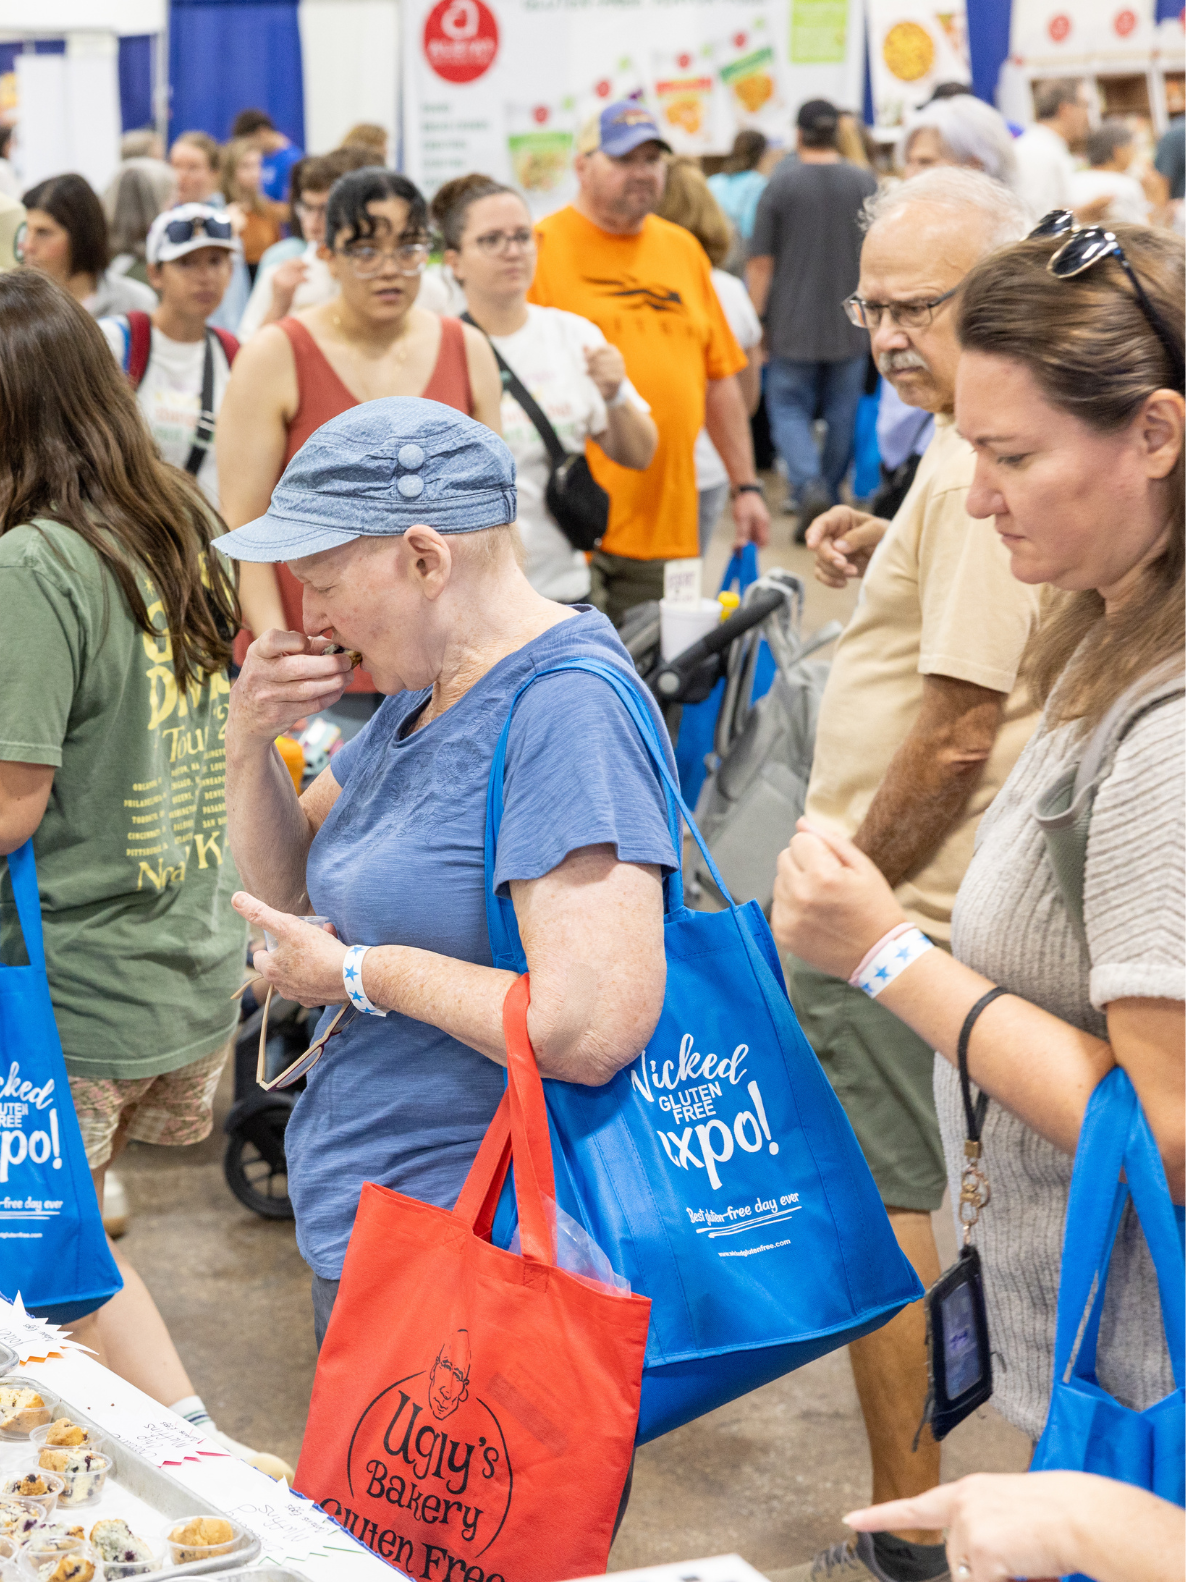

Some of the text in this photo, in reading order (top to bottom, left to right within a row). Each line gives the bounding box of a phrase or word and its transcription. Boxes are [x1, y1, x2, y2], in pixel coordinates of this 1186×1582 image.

[658, 1081, 723, 1112] GLUTEN
[672, 1100, 717, 1125] FREE
[24, 1196, 42, 1212] day
[44, 1200, 63, 1209] ever
[686, 1207, 705, 1224] Best
[755, 1197, 778, 1213] day
[780, 1192, 799, 1206] ever
[383, 1390, 499, 1495] Ugly's
[366, 1459, 484, 1541] Bakery
